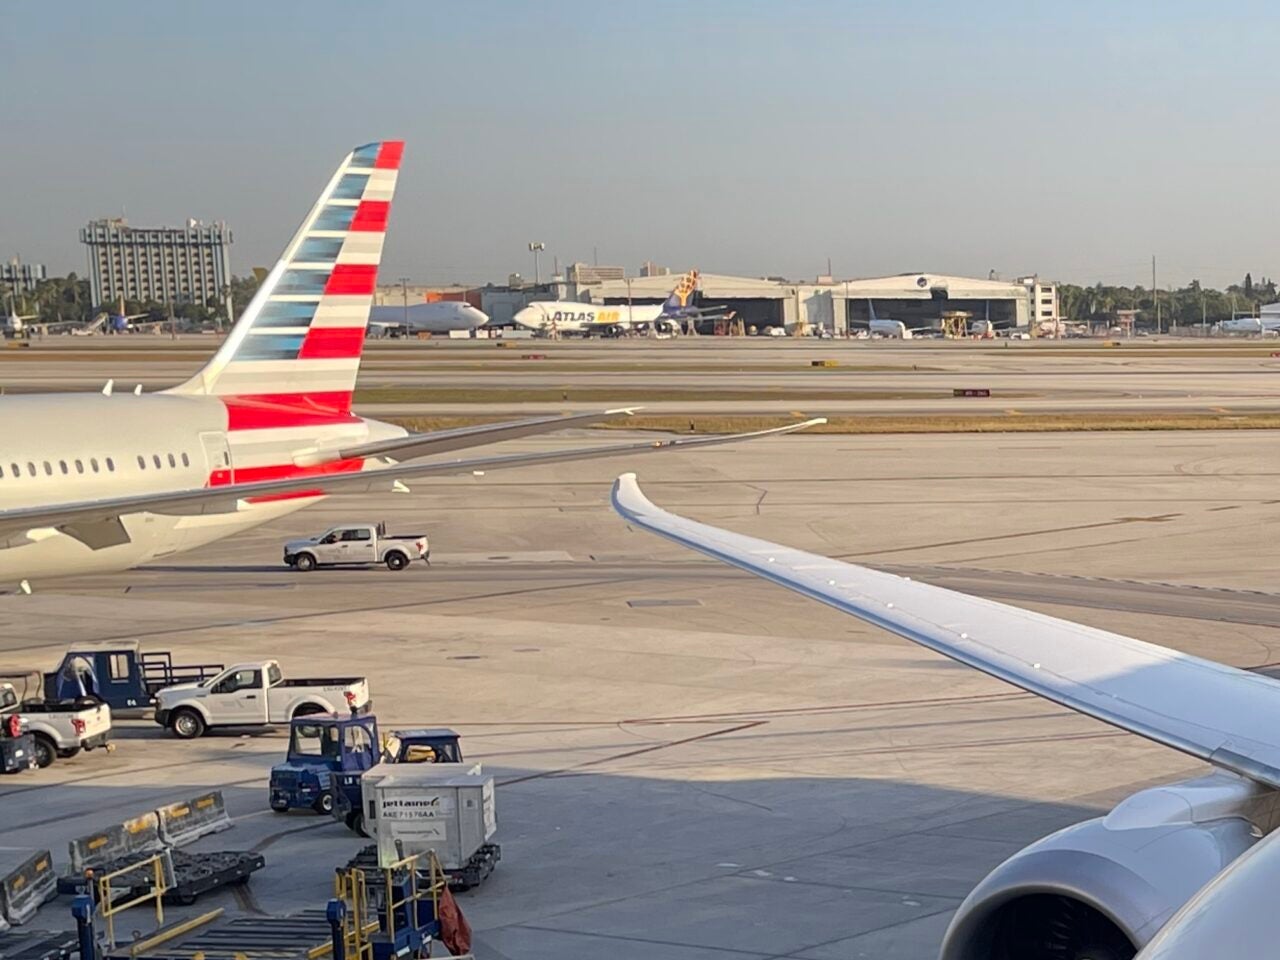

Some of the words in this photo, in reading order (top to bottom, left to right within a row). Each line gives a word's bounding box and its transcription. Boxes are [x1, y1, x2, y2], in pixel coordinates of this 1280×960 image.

[552, 311, 595, 322] ATLAS
[597, 311, 620, 321] AIR
[383, 797, 439, 809] jettainer
